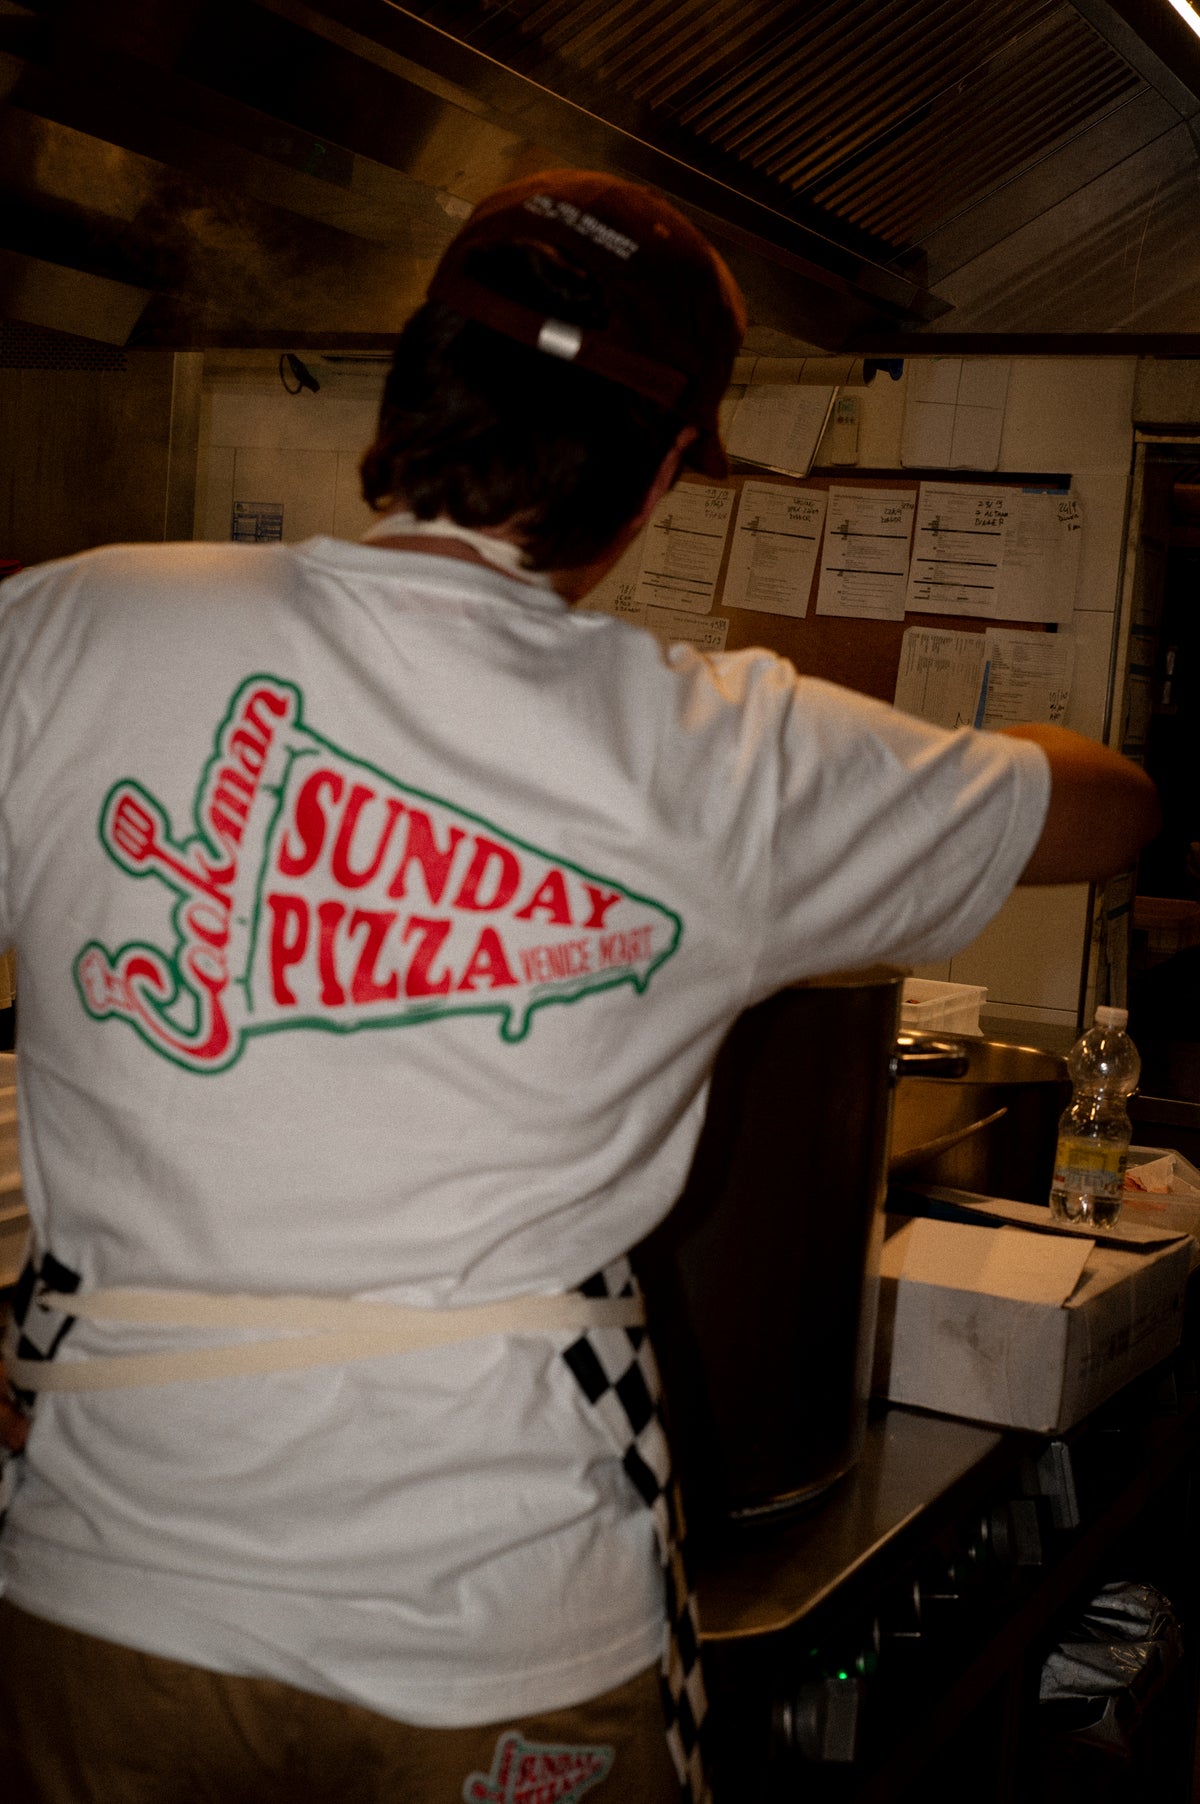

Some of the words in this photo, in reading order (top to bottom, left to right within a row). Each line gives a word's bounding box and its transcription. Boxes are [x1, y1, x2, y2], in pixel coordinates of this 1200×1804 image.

[275, 766, 623, 931] SUNDAY
[264, 890, 521, 1010] PIZZA
[519, 937, 591, 983] VENICE
